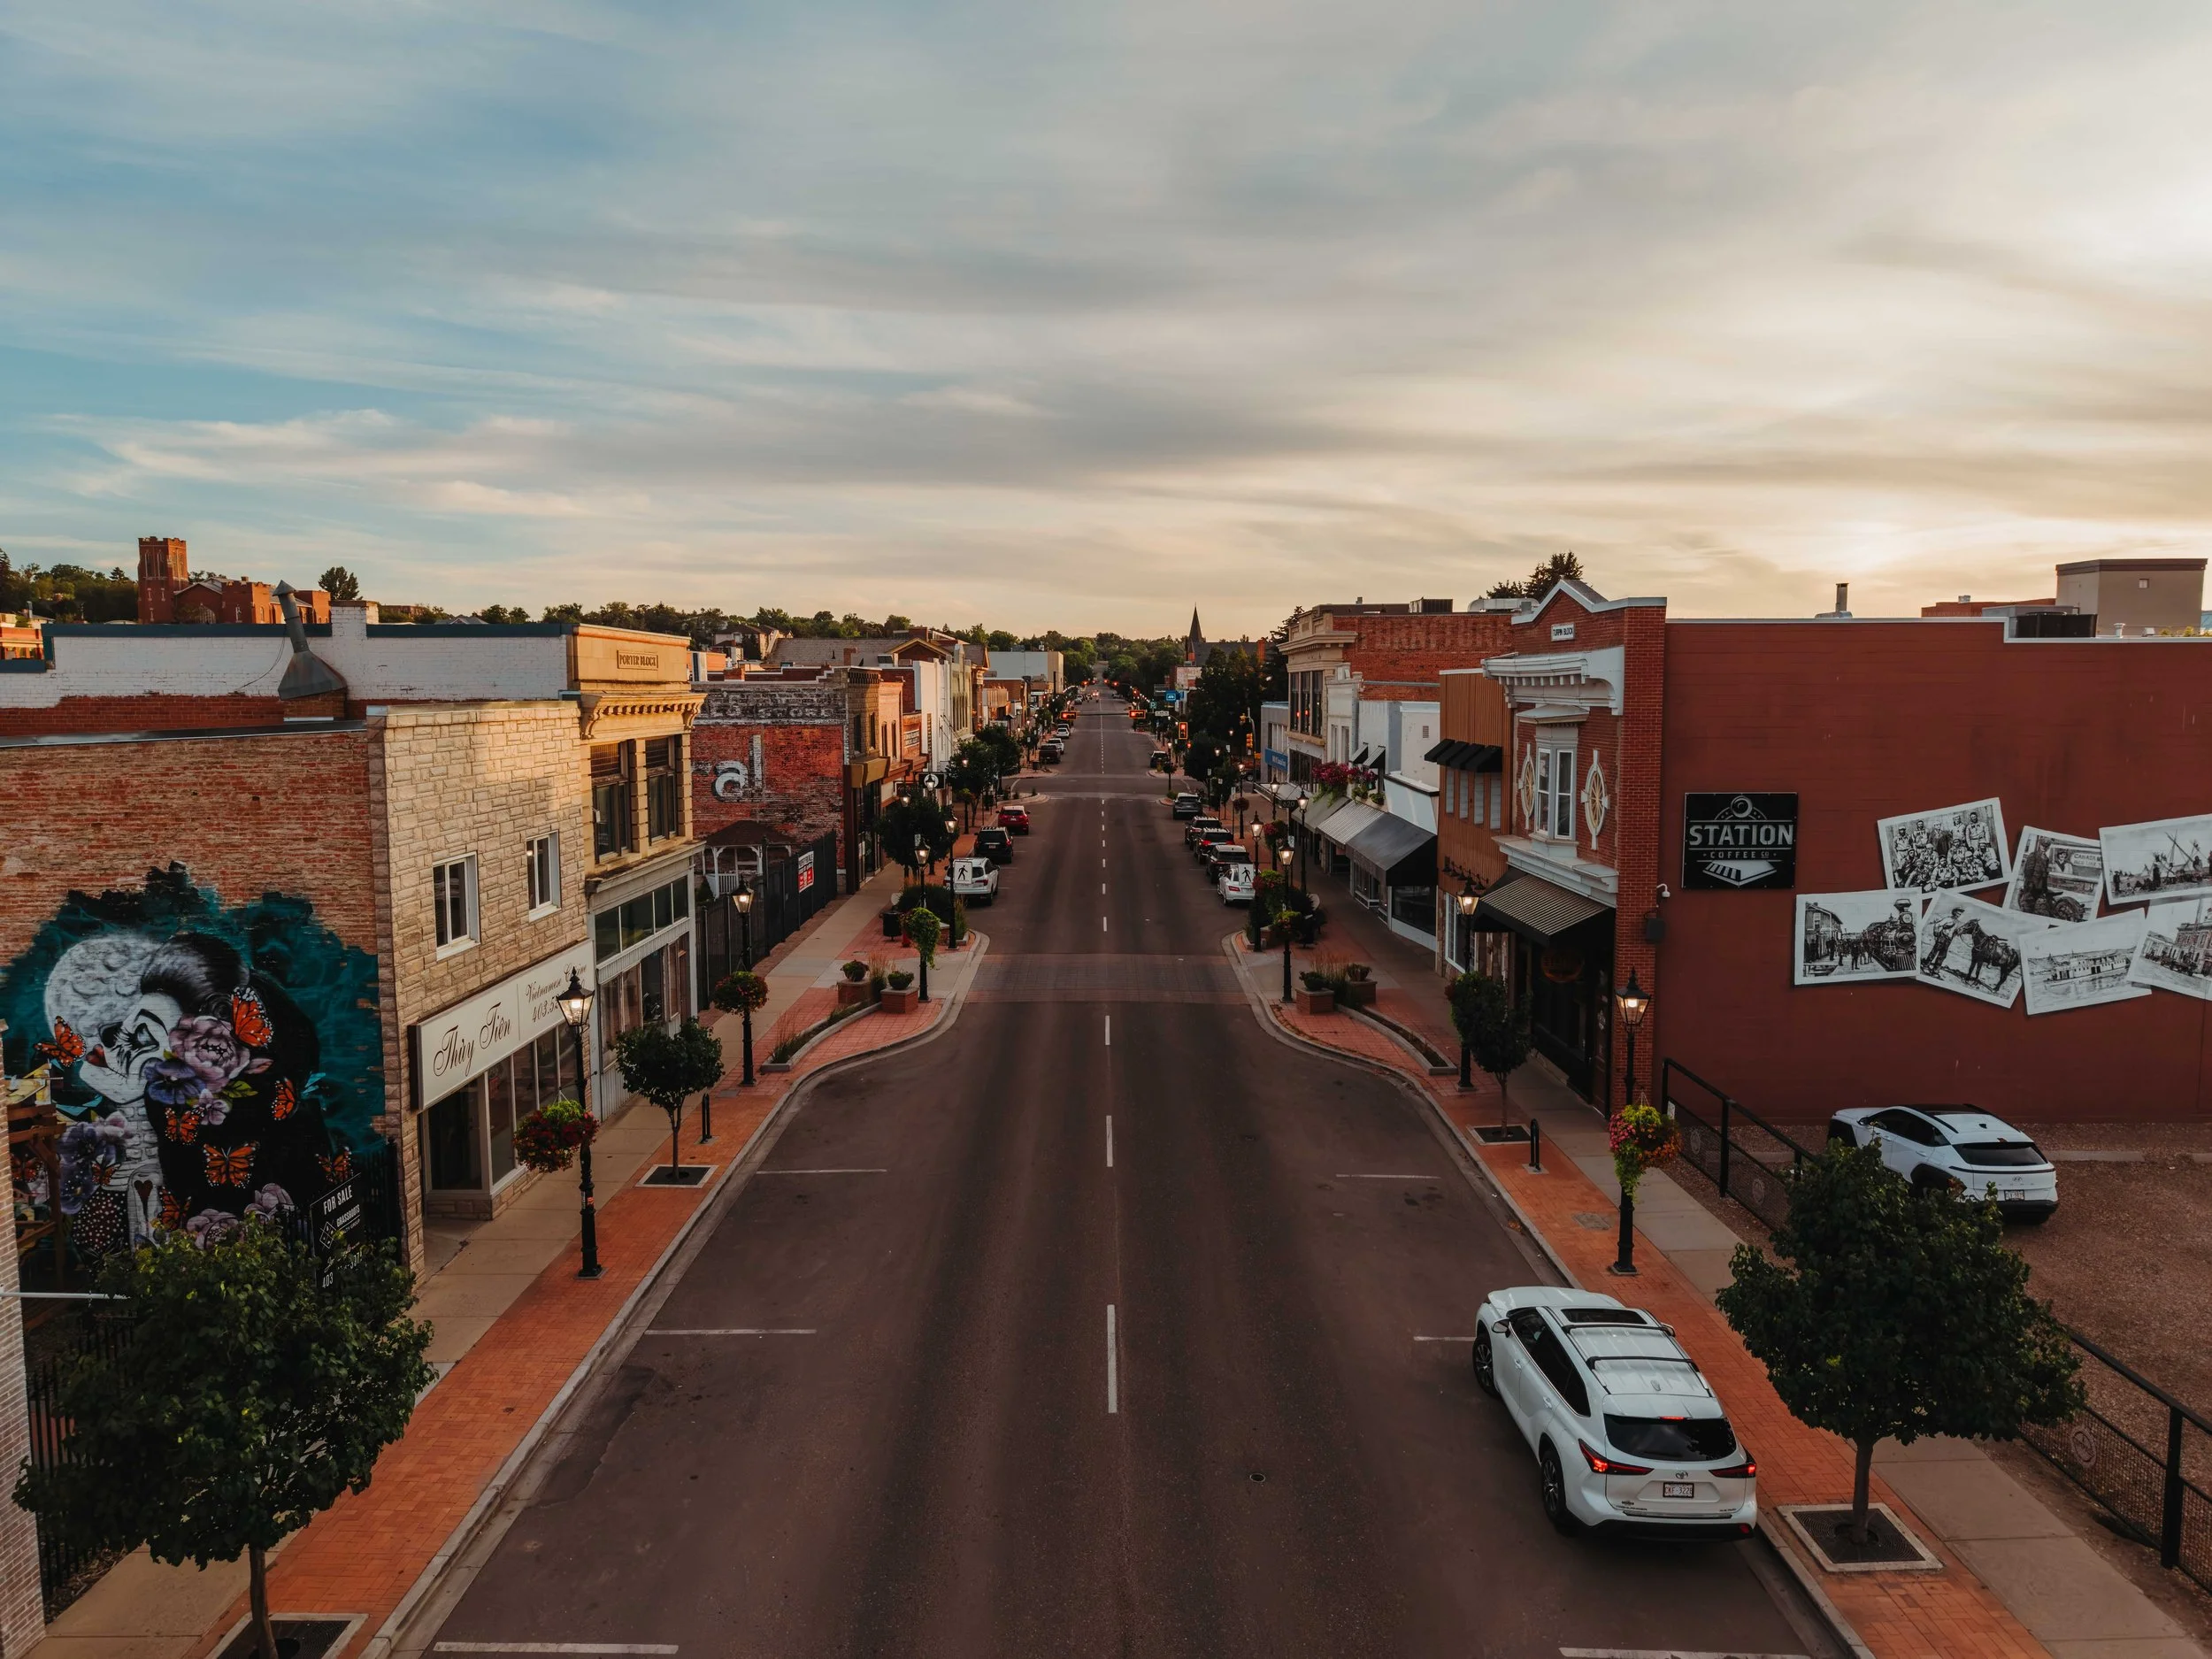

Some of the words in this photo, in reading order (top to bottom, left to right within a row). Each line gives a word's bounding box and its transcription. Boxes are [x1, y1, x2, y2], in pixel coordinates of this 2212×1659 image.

[619, 654, 640, 665] PORTER
[1689, 825, 1794, 846] STATION
[526, 978, 562, 1003] Vietnamese
[323, 1195, 337, 1216] FOR
[337, 1185, 353, 1206] SALE
[336, 1203, 361, 1227] GRASSROOTS
[322, 1271, 334, 1289] 403
